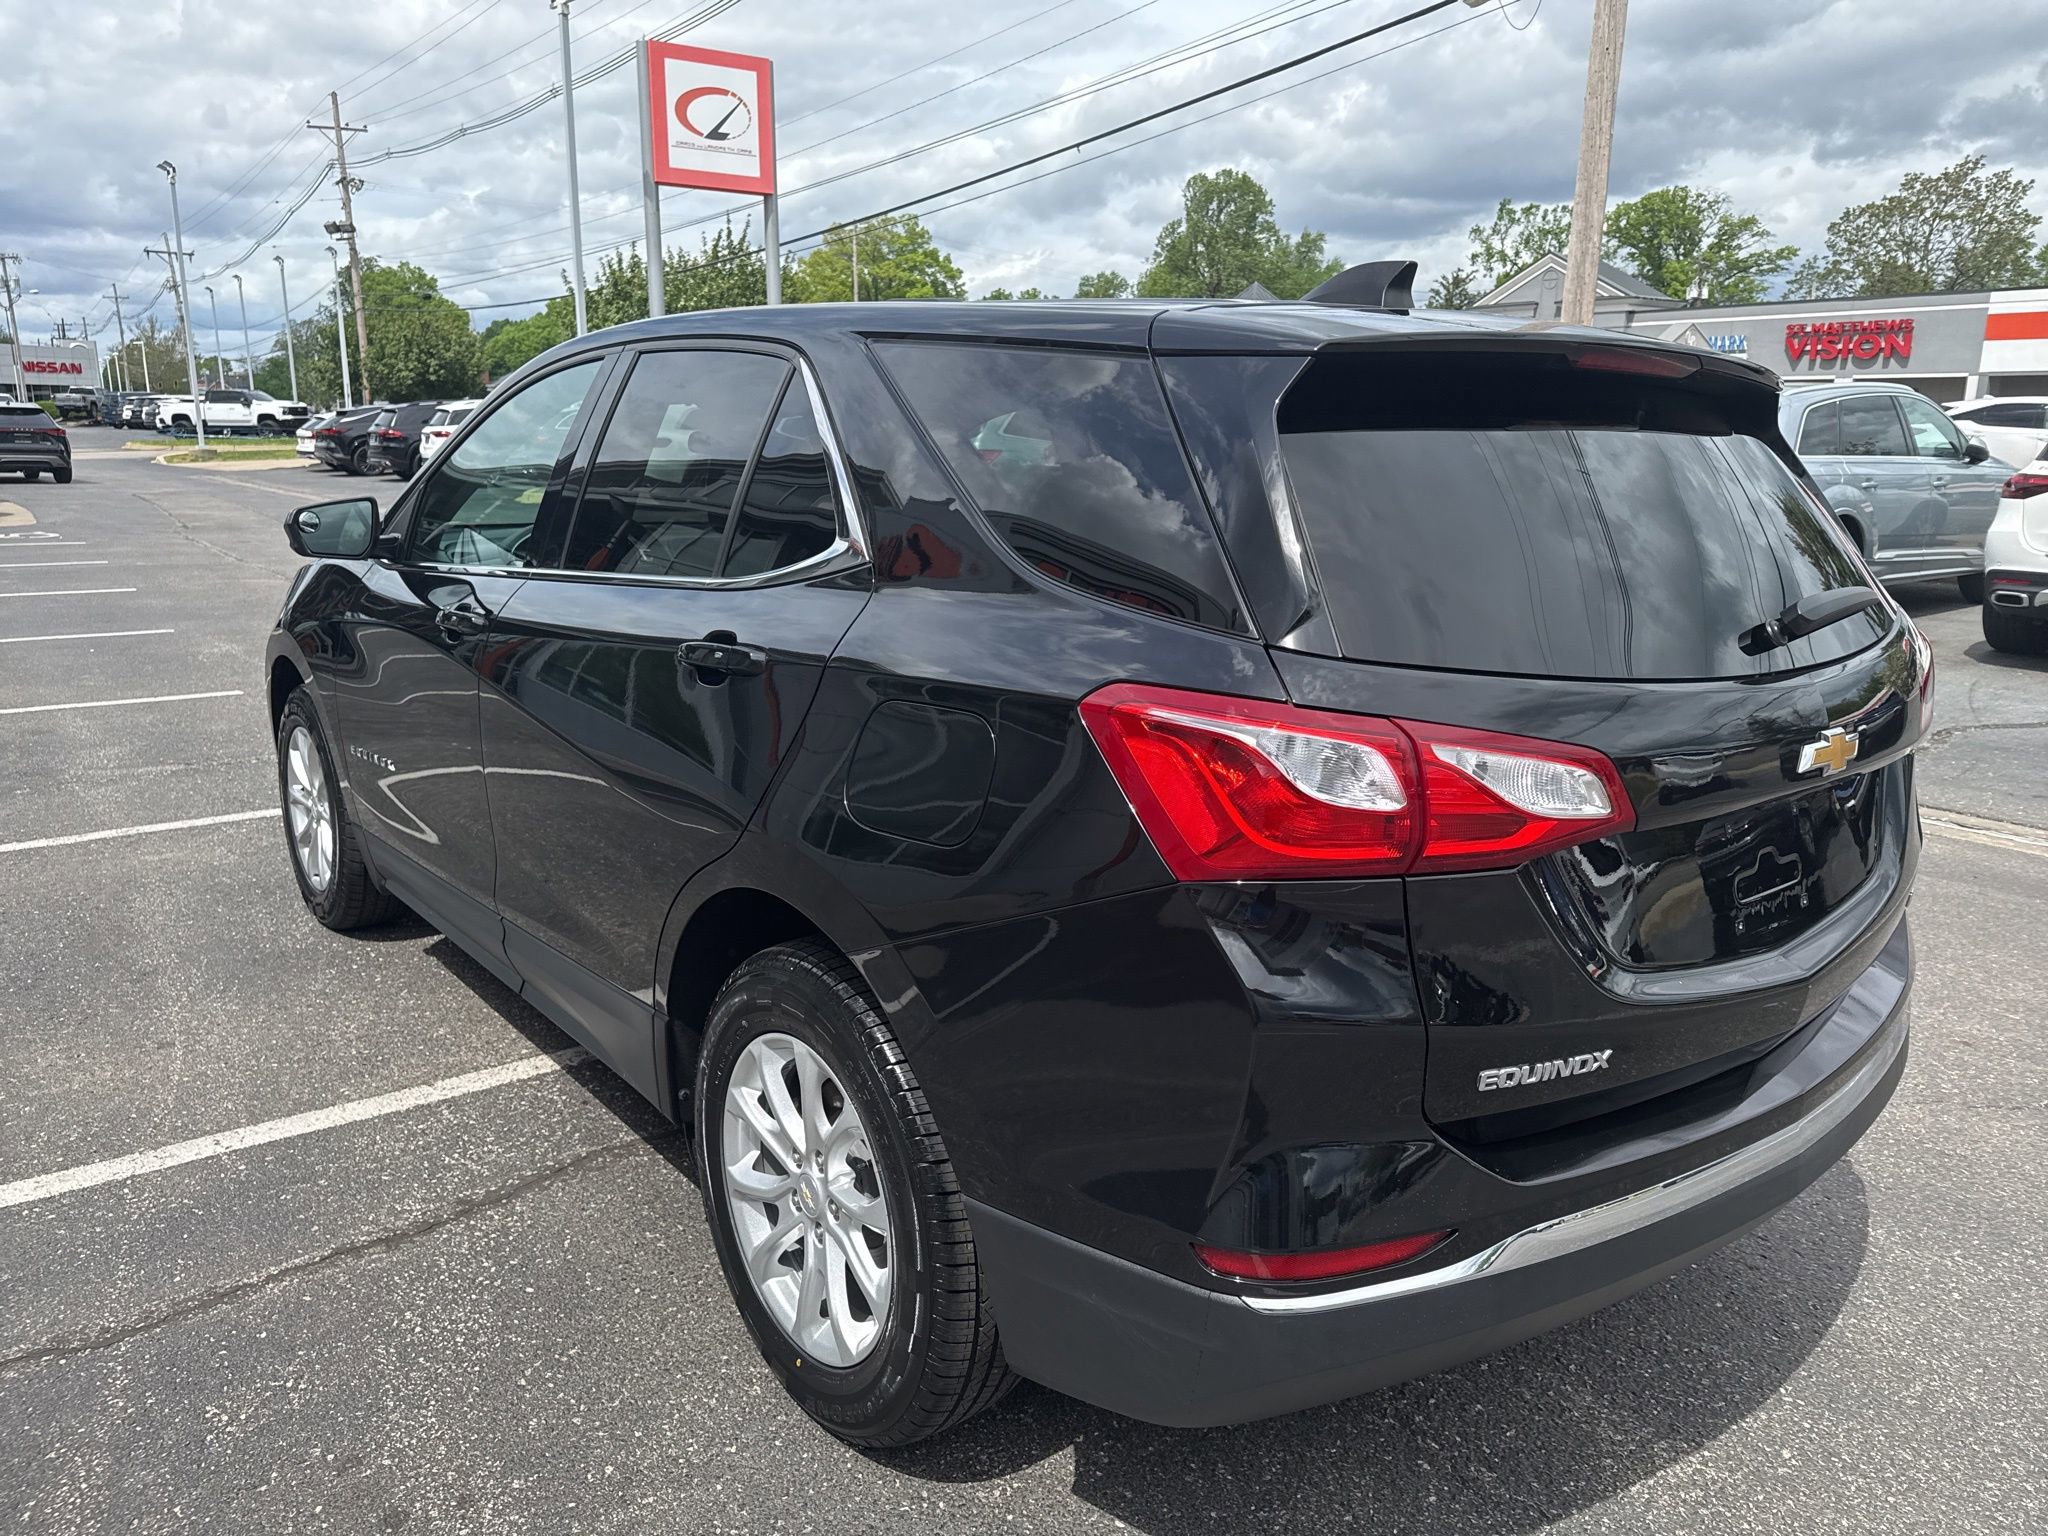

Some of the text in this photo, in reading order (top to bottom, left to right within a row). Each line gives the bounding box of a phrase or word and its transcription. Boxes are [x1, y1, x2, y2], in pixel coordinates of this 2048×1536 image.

[1811, 319, 1914, 334] MATTHEWS
[1786, 333, 1912, 361] VISION
[21, 361, 83, 374] NISSAN
[1477, 1049, 1613, 1092] EQUINOX
